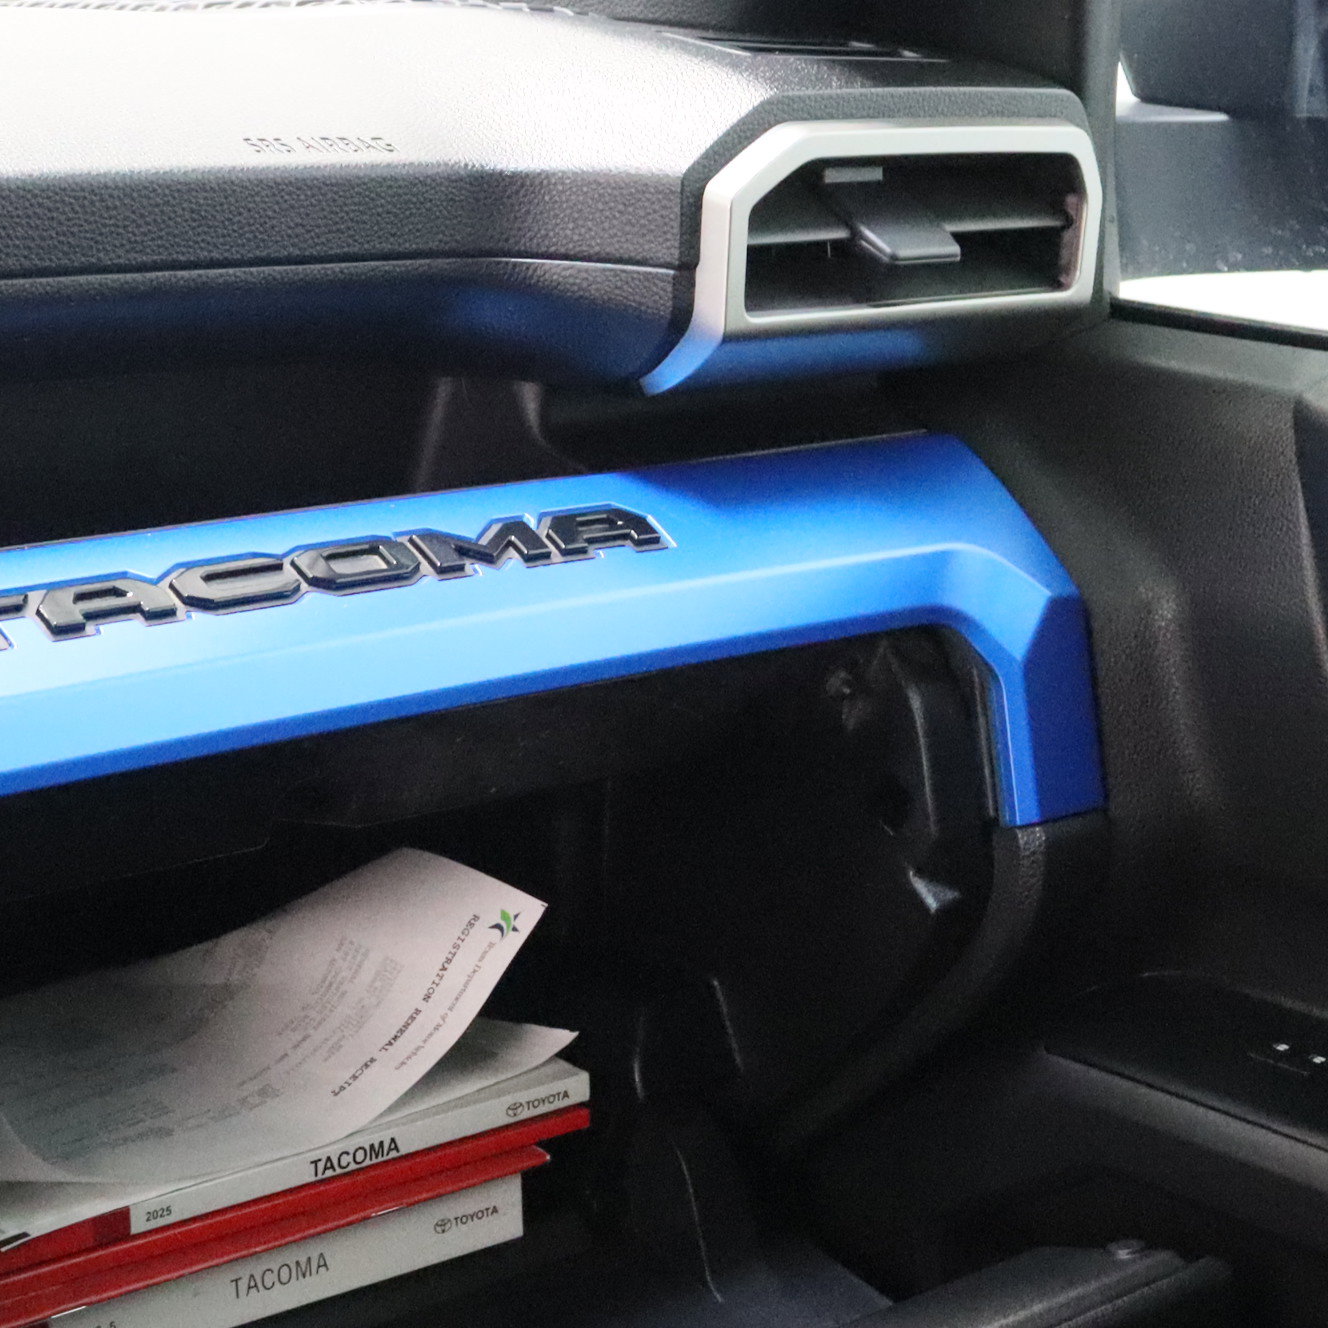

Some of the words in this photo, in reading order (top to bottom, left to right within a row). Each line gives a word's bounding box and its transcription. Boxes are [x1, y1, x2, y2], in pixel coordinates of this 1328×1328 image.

[422, 913, 480, 1003] REGISTRATION
[378, 1007, 422, 1053] RENEWAL
[330, 1056, 378, 1098] RECEIPT
[144, 1205, 173, 1223] 2025
[309, 1135, 401, 1178] TACOMA
[526, 1088, 571, 1113] TOYOTA
[229, 1250, 331, 1301] TACOMA
[452, 1203, 500, 1228] TOYOTA
